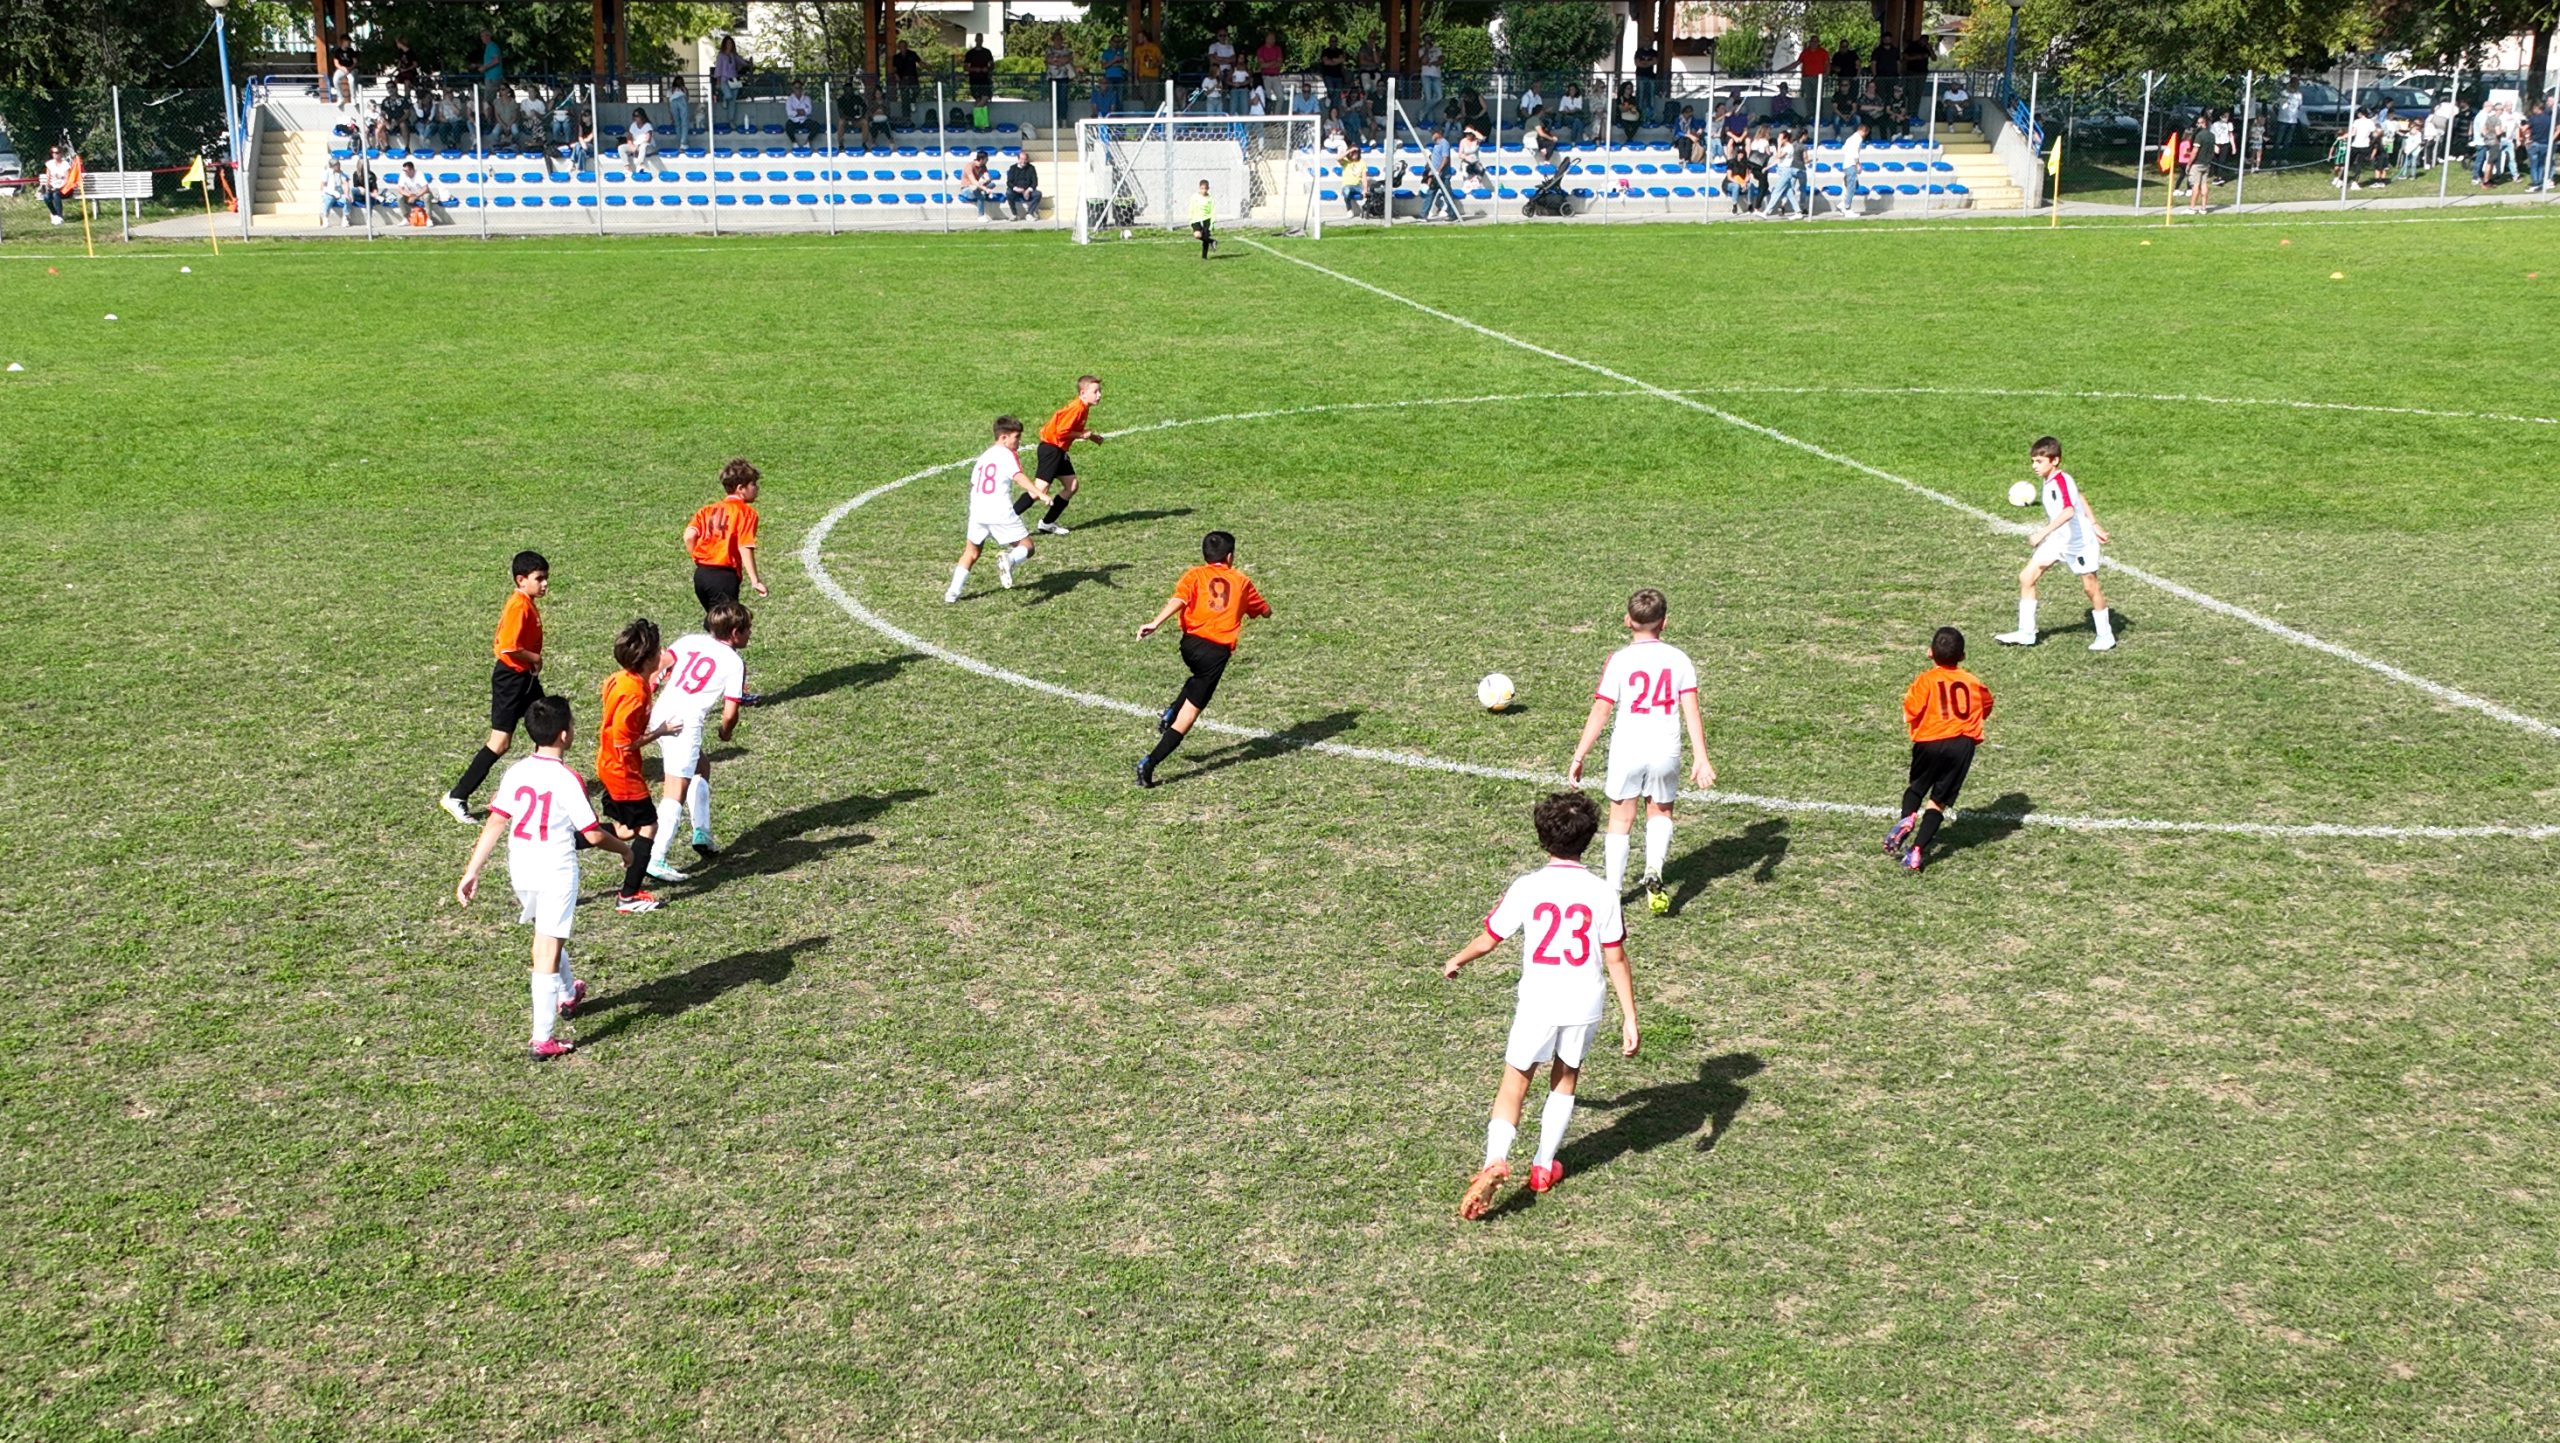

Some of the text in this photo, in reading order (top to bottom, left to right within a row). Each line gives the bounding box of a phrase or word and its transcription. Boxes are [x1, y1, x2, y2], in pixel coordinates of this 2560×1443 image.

[976, 463, 997, 495] 18
[675, 651, 716, 694] 19
[1628, 668, 1675, 715] 24
[1937, 680, 1971, 721] 10
[513, 785, 552, 842] 21
[1532, 902, 1593, 967] 23
